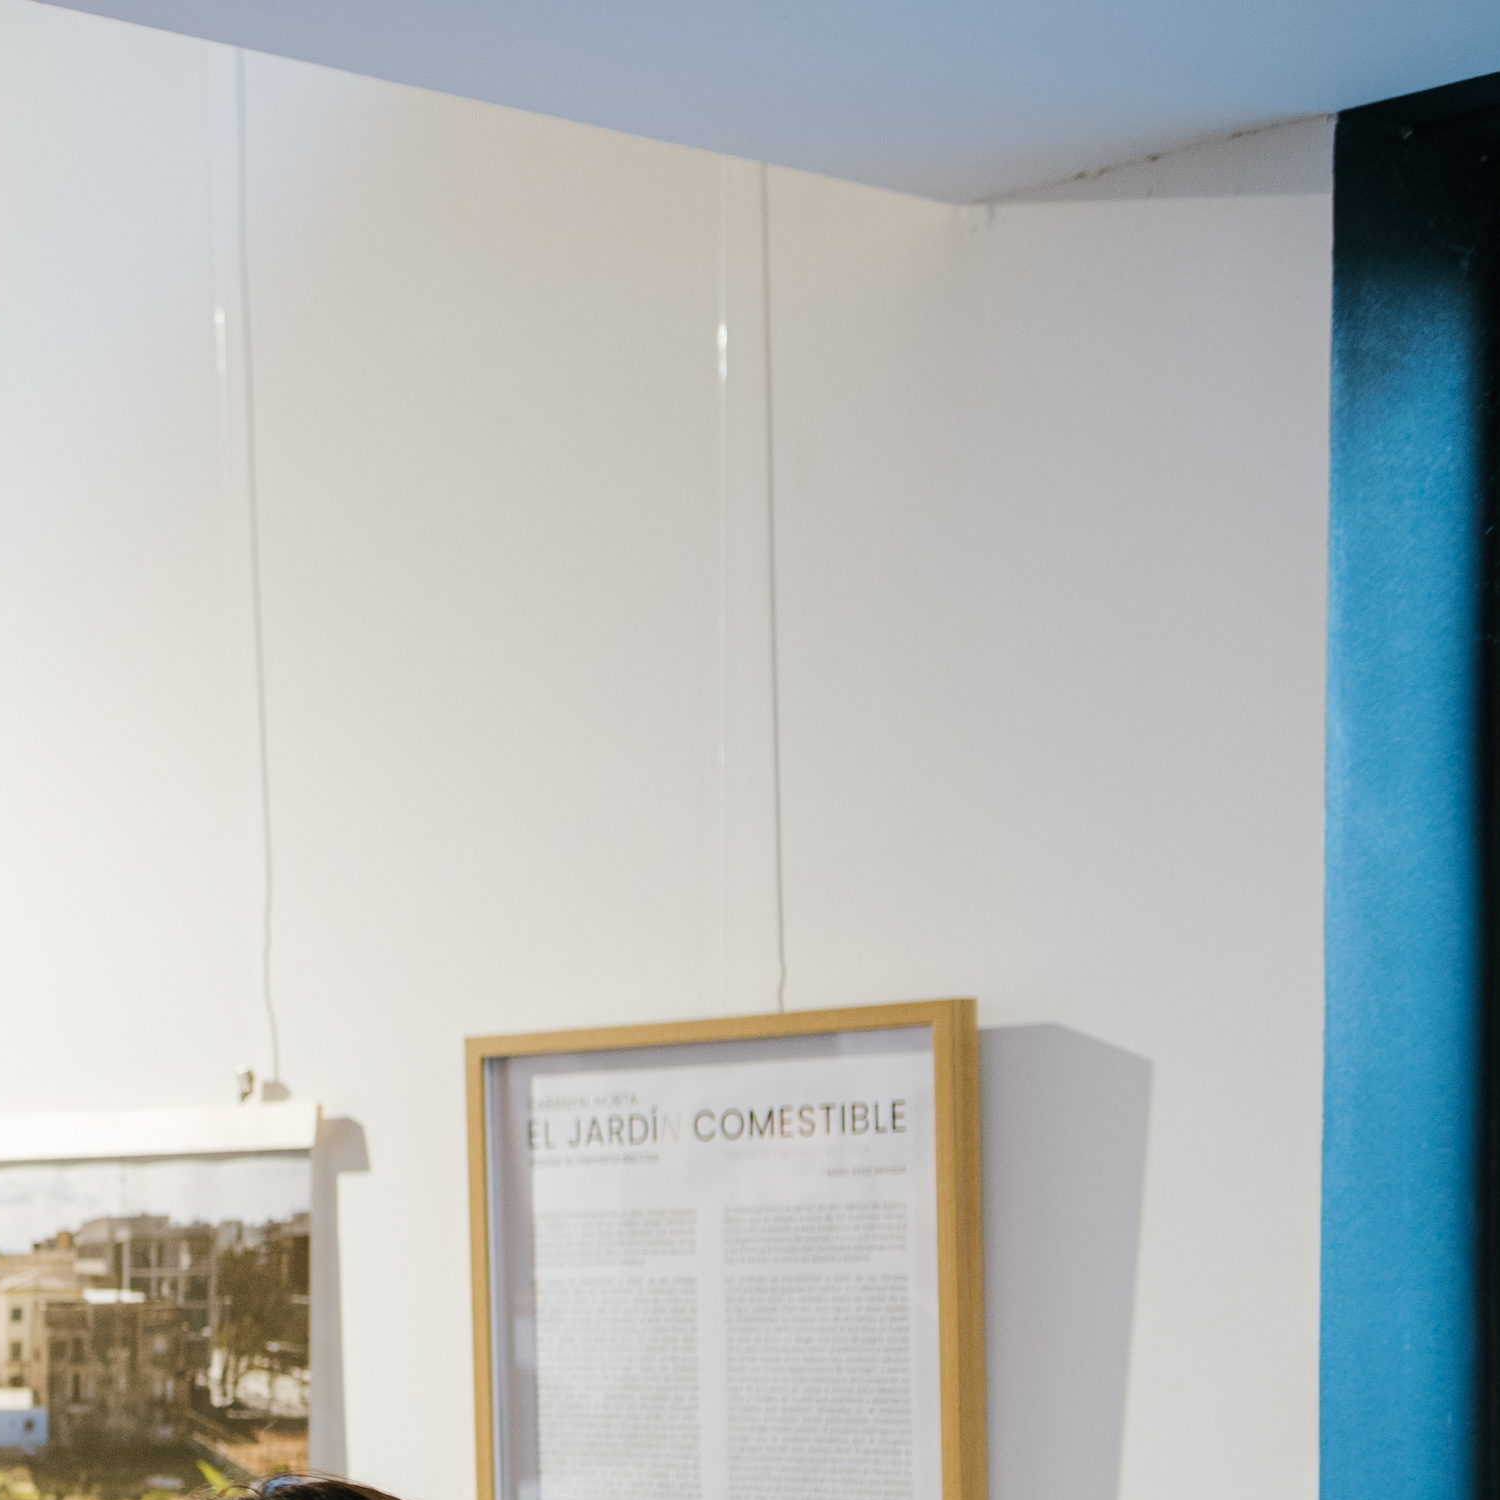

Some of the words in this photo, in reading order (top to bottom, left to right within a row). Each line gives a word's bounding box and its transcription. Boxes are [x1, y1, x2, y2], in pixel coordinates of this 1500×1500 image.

[528, 1117, 556, 1149] EL
[568, 1103, 682, 1149] JARDÍN
[693, 1099, 907, 1143] COMESTIBLE
